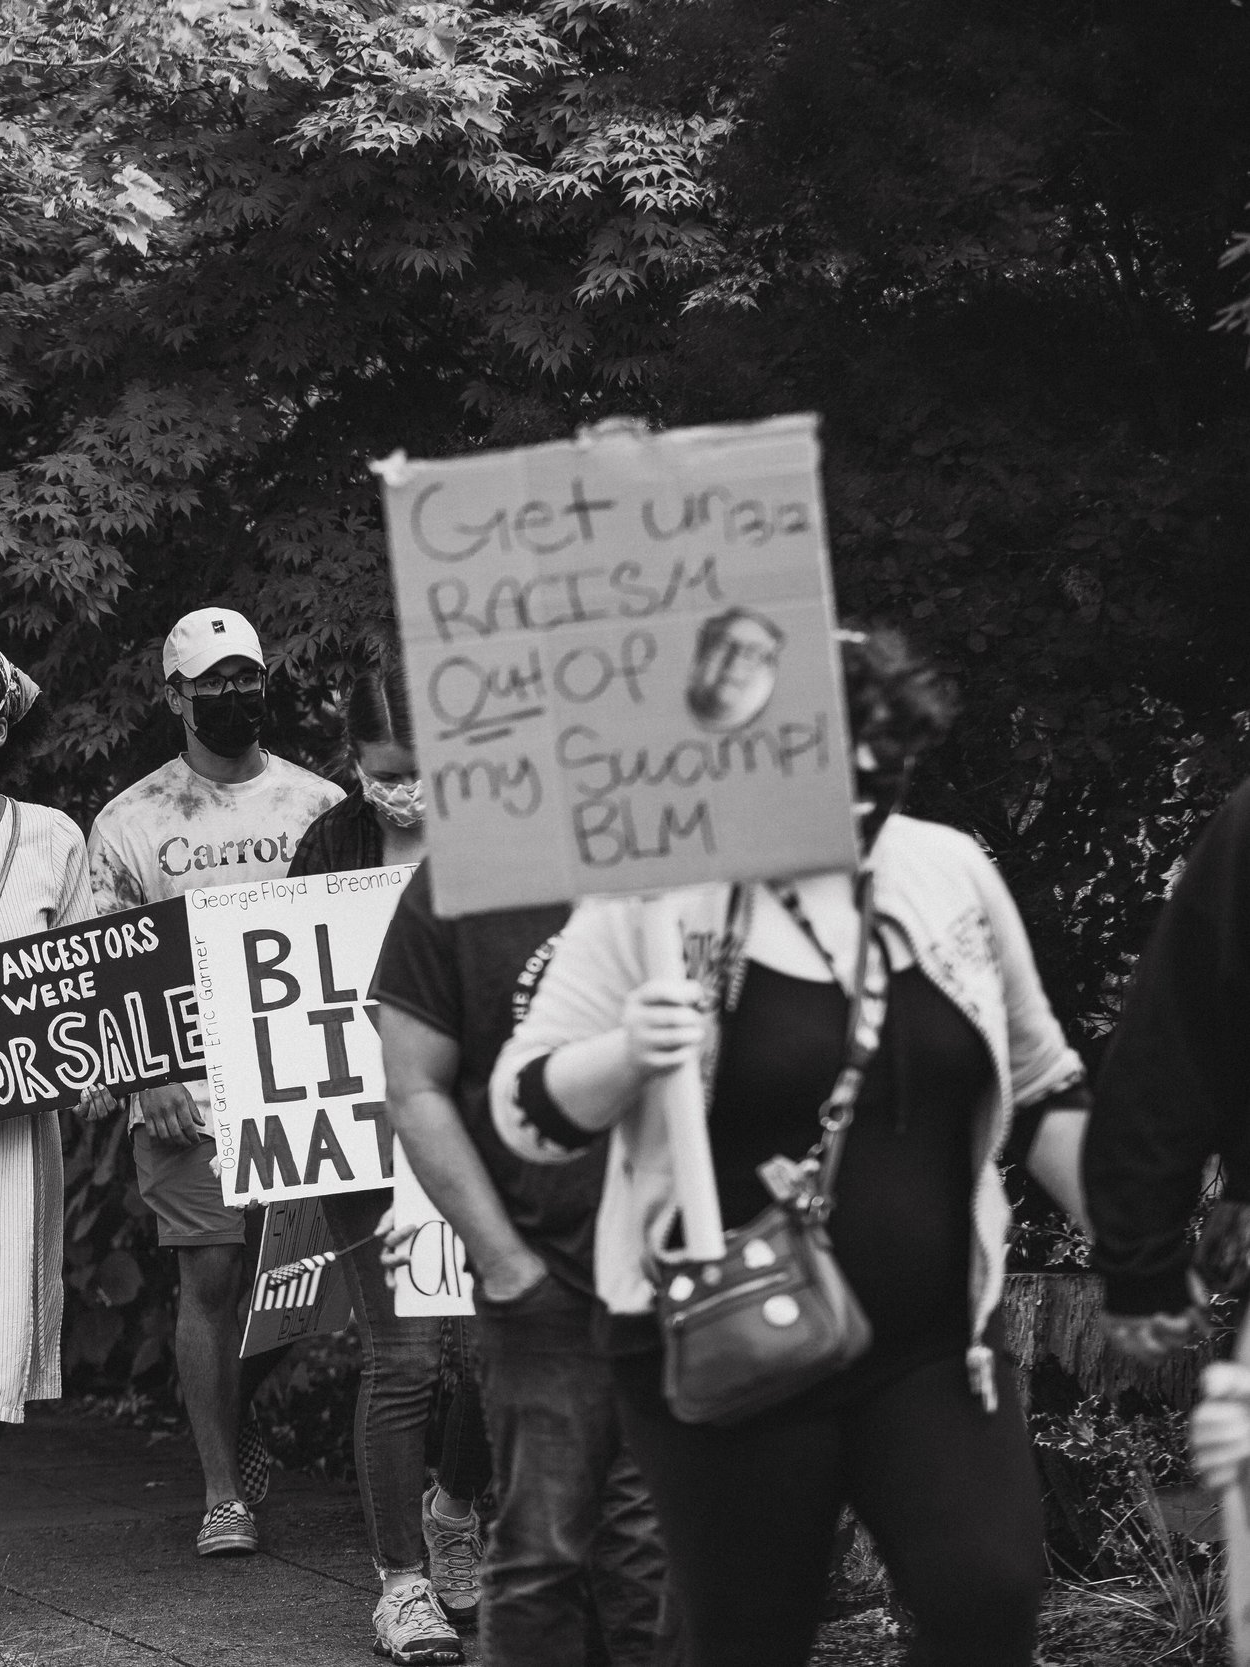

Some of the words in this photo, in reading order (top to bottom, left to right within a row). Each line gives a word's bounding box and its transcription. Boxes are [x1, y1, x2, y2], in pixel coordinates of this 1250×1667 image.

[410, 476, 617, 563] Get
[427, 554, 724, 643] RACISM
[159, 831, 303, 877] Carrot
[571, 797, 718, 869] BLM
[191, 888, 259, 911] George
[261, 876, 308, 904] Floyd
[326, 870, 403, 895] Breonna
[3, 917, 159, 985] ANCESTORS
[194, 935, 214, 1001] Garner
[243, 923, 358, 1013] BL
[1, 971, 97, 1015] WERE
[47, 984, 206, 1090] SALE
[204, 1009, 221, 1047] Eric
[253, 1004, 382, 1104] LI
[208, 1064, 228, 1113] Grant
[219, 1118, 236, 1170] Oscar
[235, 1101, 395, 1194] MAT
